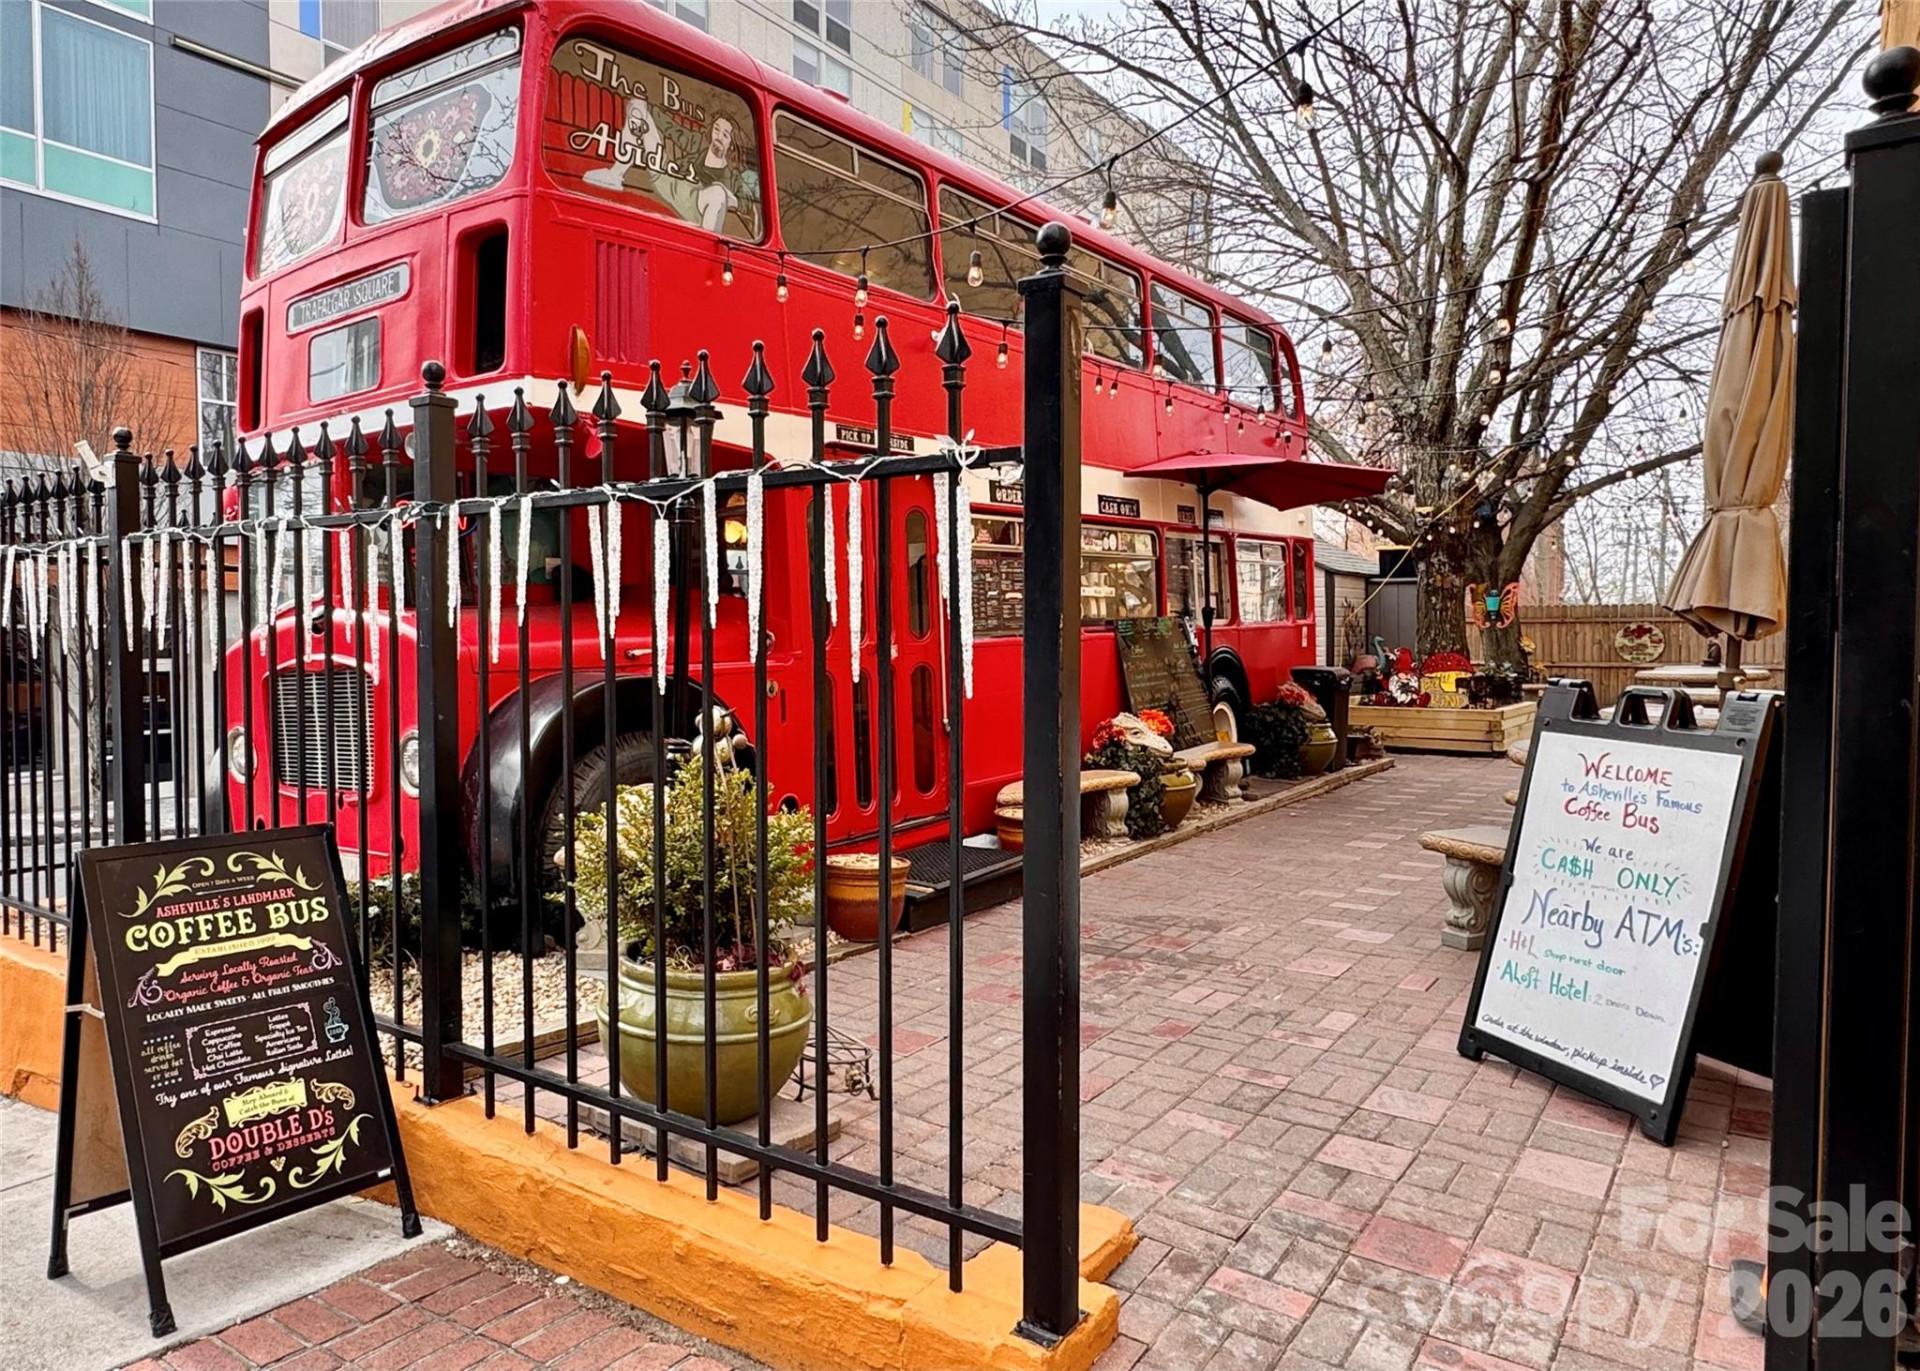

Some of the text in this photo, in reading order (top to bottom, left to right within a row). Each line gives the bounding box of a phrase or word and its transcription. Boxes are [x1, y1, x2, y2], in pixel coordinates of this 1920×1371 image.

[574, 42, 705, 122] The Bus
[570, 121, 699, 183] Abides
[301, 273, 395, 321] TRAFALGAR SQUARE
[840, 430, 858, 441] PICK
[861, 433, 871, 442] UP
[996, 488, 1022, 503] ORDER
[1100, 501, 1118, 514] CASH
[1560, 777, 1703, 815] to Asheville's Famous
[1564, 796, 1660, 835] Coffee Bus
[1581, 836, 1634, 861] We are
[1617, 867, 1680, 898] ONLY
[156, 887, 296, 919] ASHEVILLE'S LANDMARK
[1521, 887, 1605, 950] Nearby
[125, 896, 329, 952] COFFEE BUS
[194, 938, 255, 955] ESTABLISHED
[179, 951, 298, 984] Serving Locally Roasted
[1568, 955, 1593, 967] next
[1596, 959, 1626, 977] door
[163, 964, 314, 1004] Organic Coffee & Organic Teas
[201, 1032, 243, 1047] Cappuccino
[204, 1025, 237, 1037] Espresso
[217, 1040, 242, 1052] Coffee
[254, 1030, 286, 1044] Specialty
[265, 1035, 301, 1048] Americano
[156, 1041, 182, 1059] coffee
[216, 1055, 252, 1069] Chocolate
[1519, 1026, 1534, 1041] the
[1571, 1046, 1608, 1070] pickup
[1608, 1058, 1648, 1085] inside
[155, 1044, 354, 1108] Try one of our Famous Signature Lattes!
[208, 1113, 303, 1160] DOUBLE
[212, 1126, 336, 1172] COFFEE & DESSERTS
